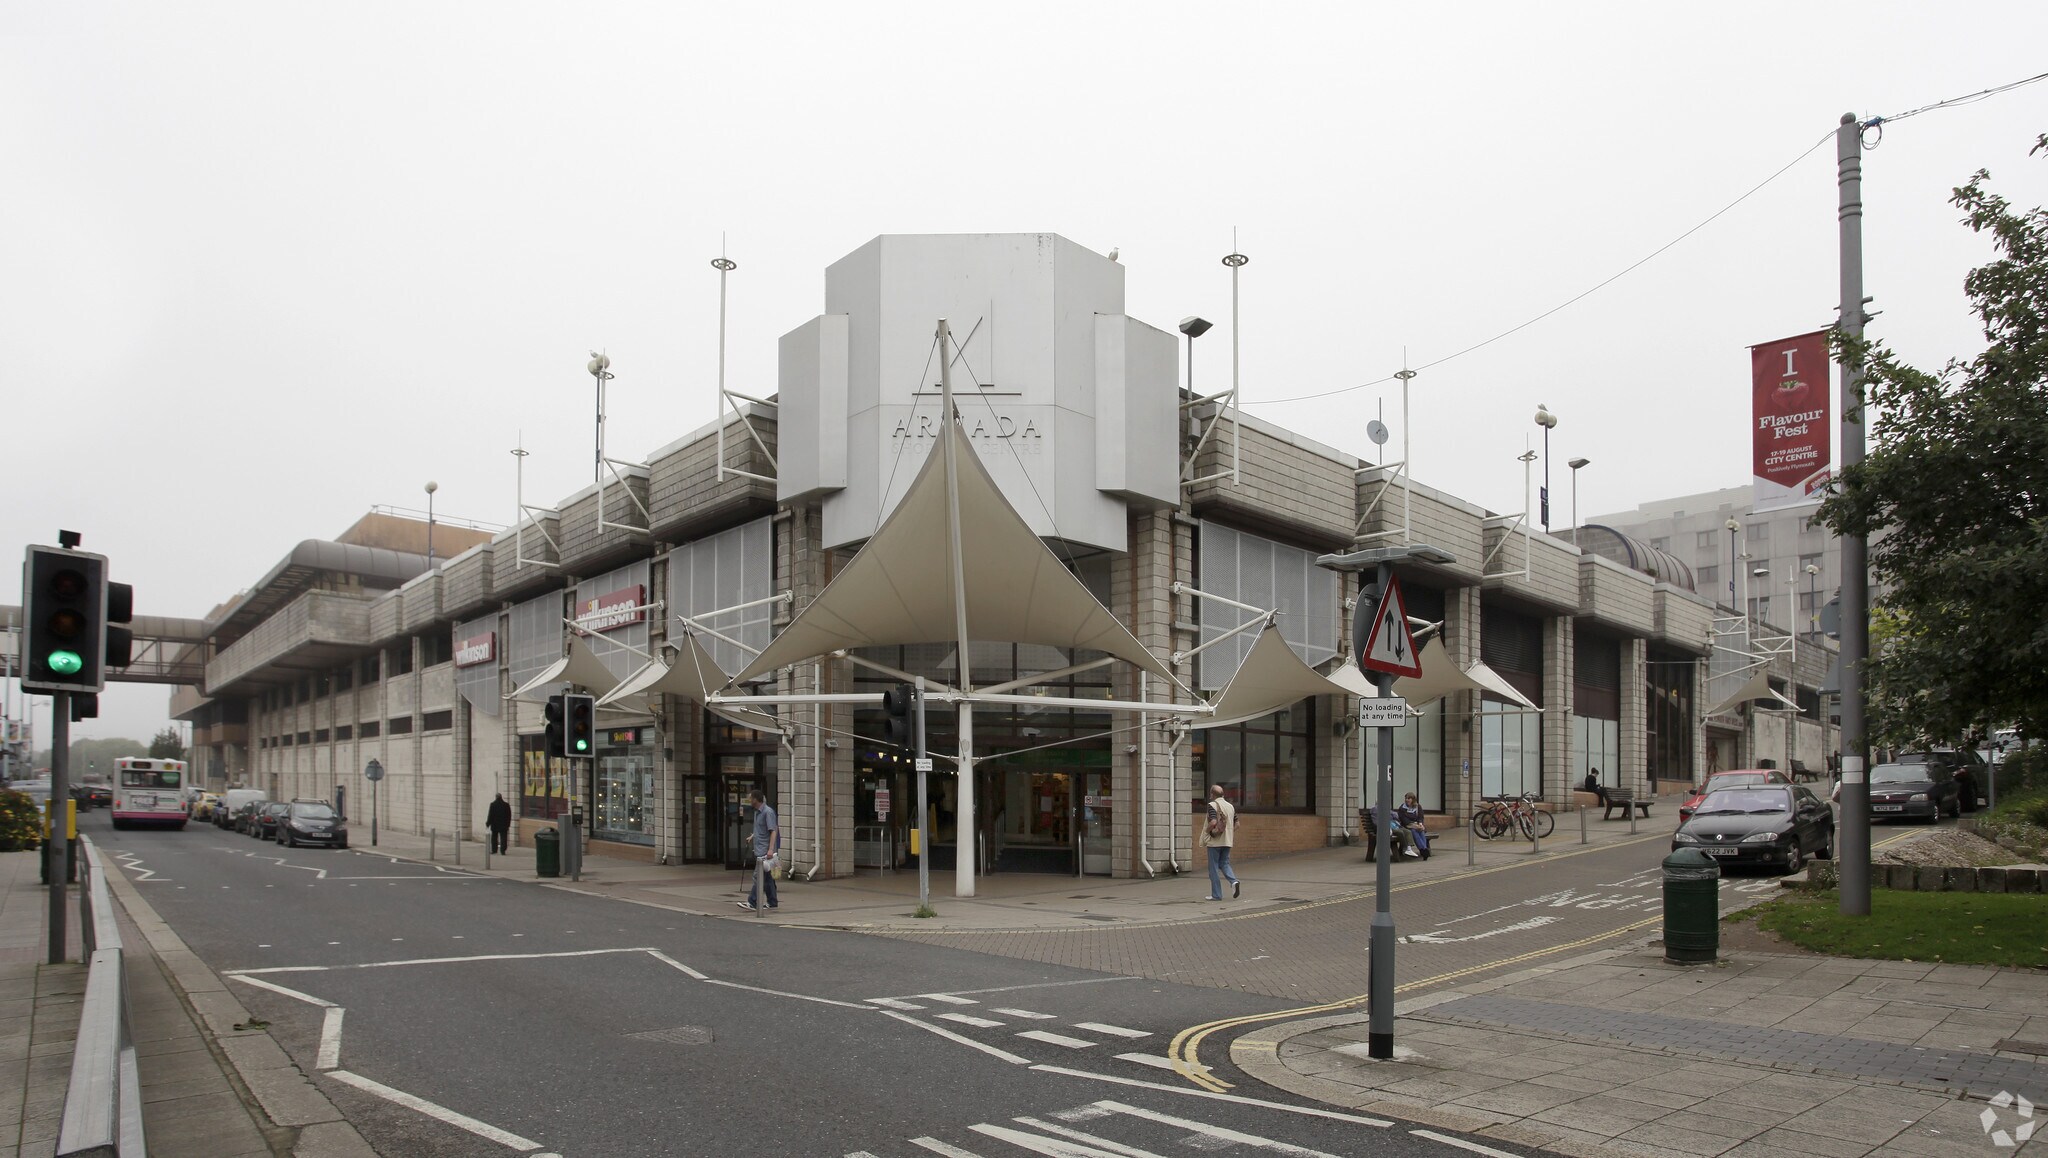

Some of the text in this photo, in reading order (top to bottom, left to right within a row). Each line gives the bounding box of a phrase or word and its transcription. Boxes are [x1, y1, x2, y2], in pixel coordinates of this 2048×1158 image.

[1782, 349, 1798, 377] I
[1759, 409, 1823, 429] Flavour
[1773, 423, 1809, 439] Fest
[1765, 450, 1818, 466] CITY CENTRE
[1770, 445, 1813, 457] 17-19 AUGUST
